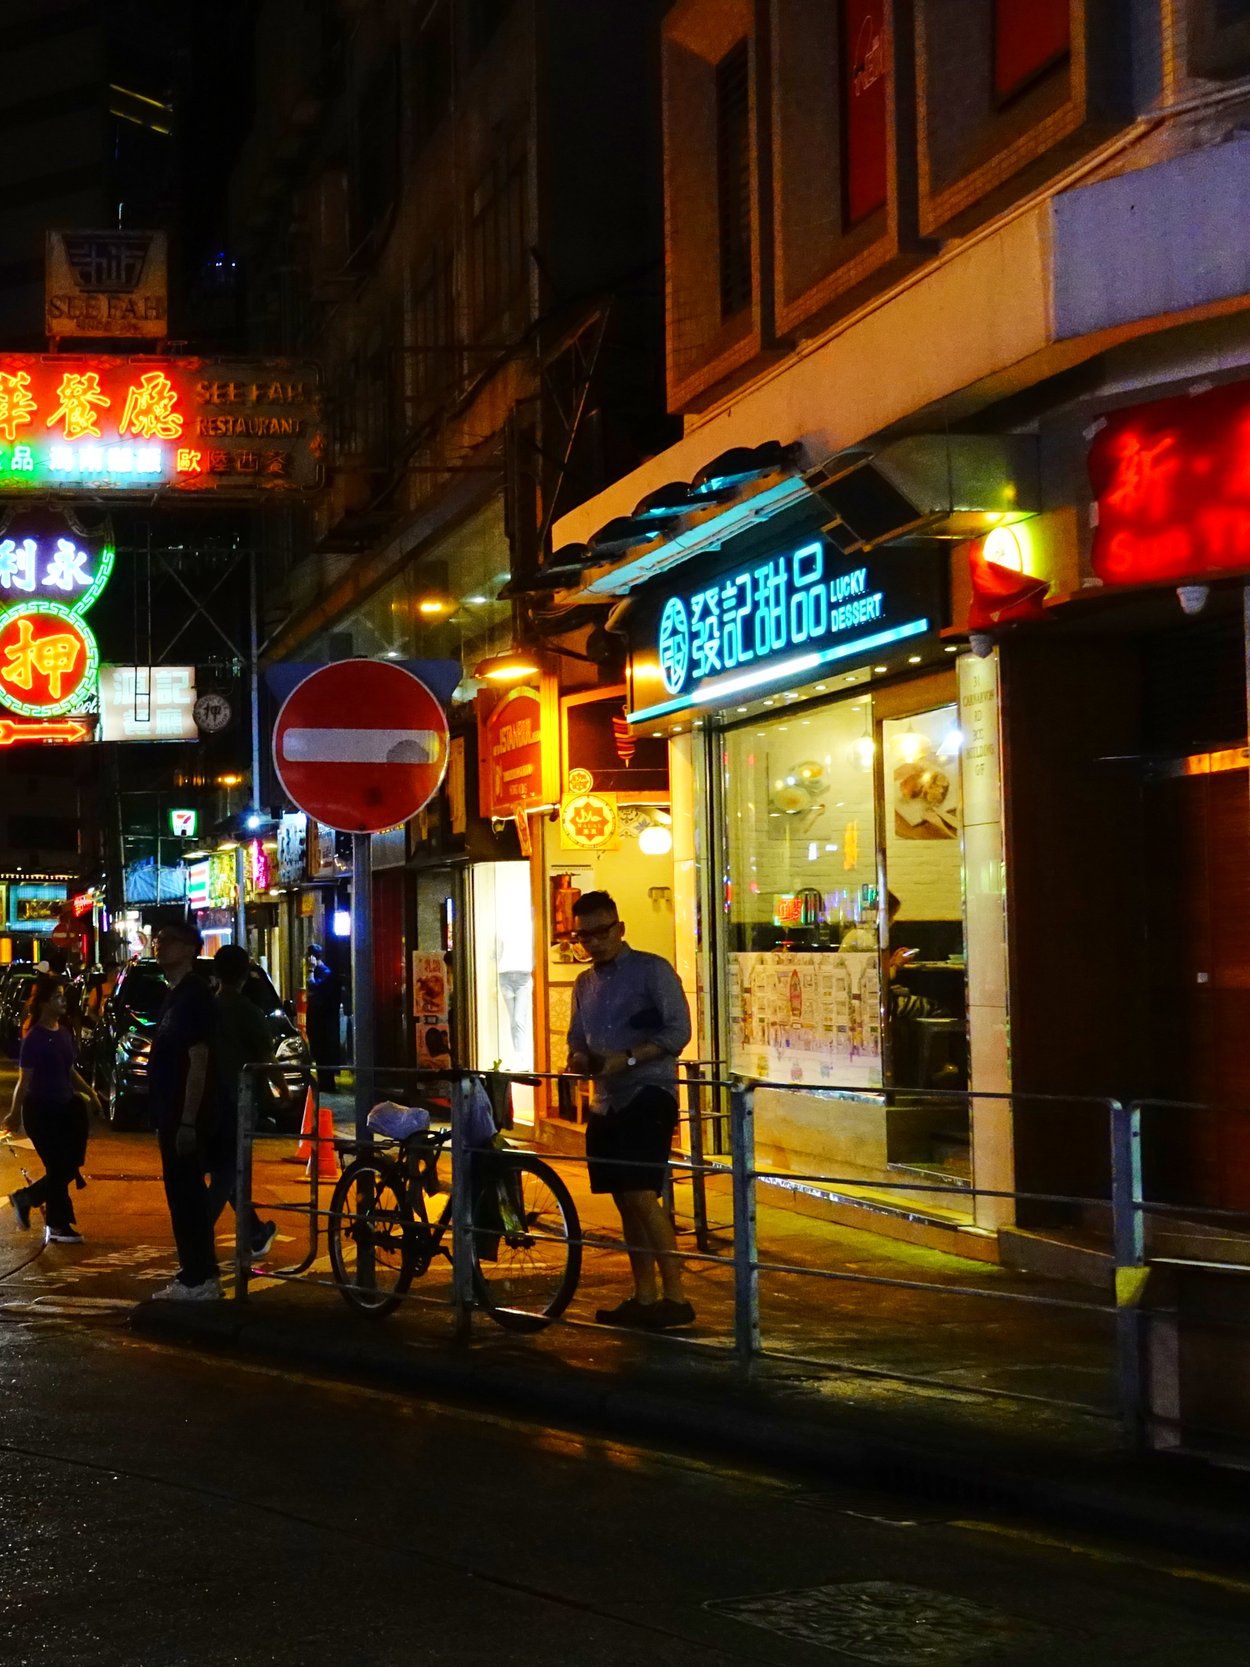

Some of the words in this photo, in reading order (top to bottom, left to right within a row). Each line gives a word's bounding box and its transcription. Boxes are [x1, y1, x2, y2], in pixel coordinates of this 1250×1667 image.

[197, 415, 301, 436] RESTAURANT
[830, 568, 867, 604] LUCKY
[831, 593, 883, 633] DESSERT
[1, 619, 81, 699] 押
